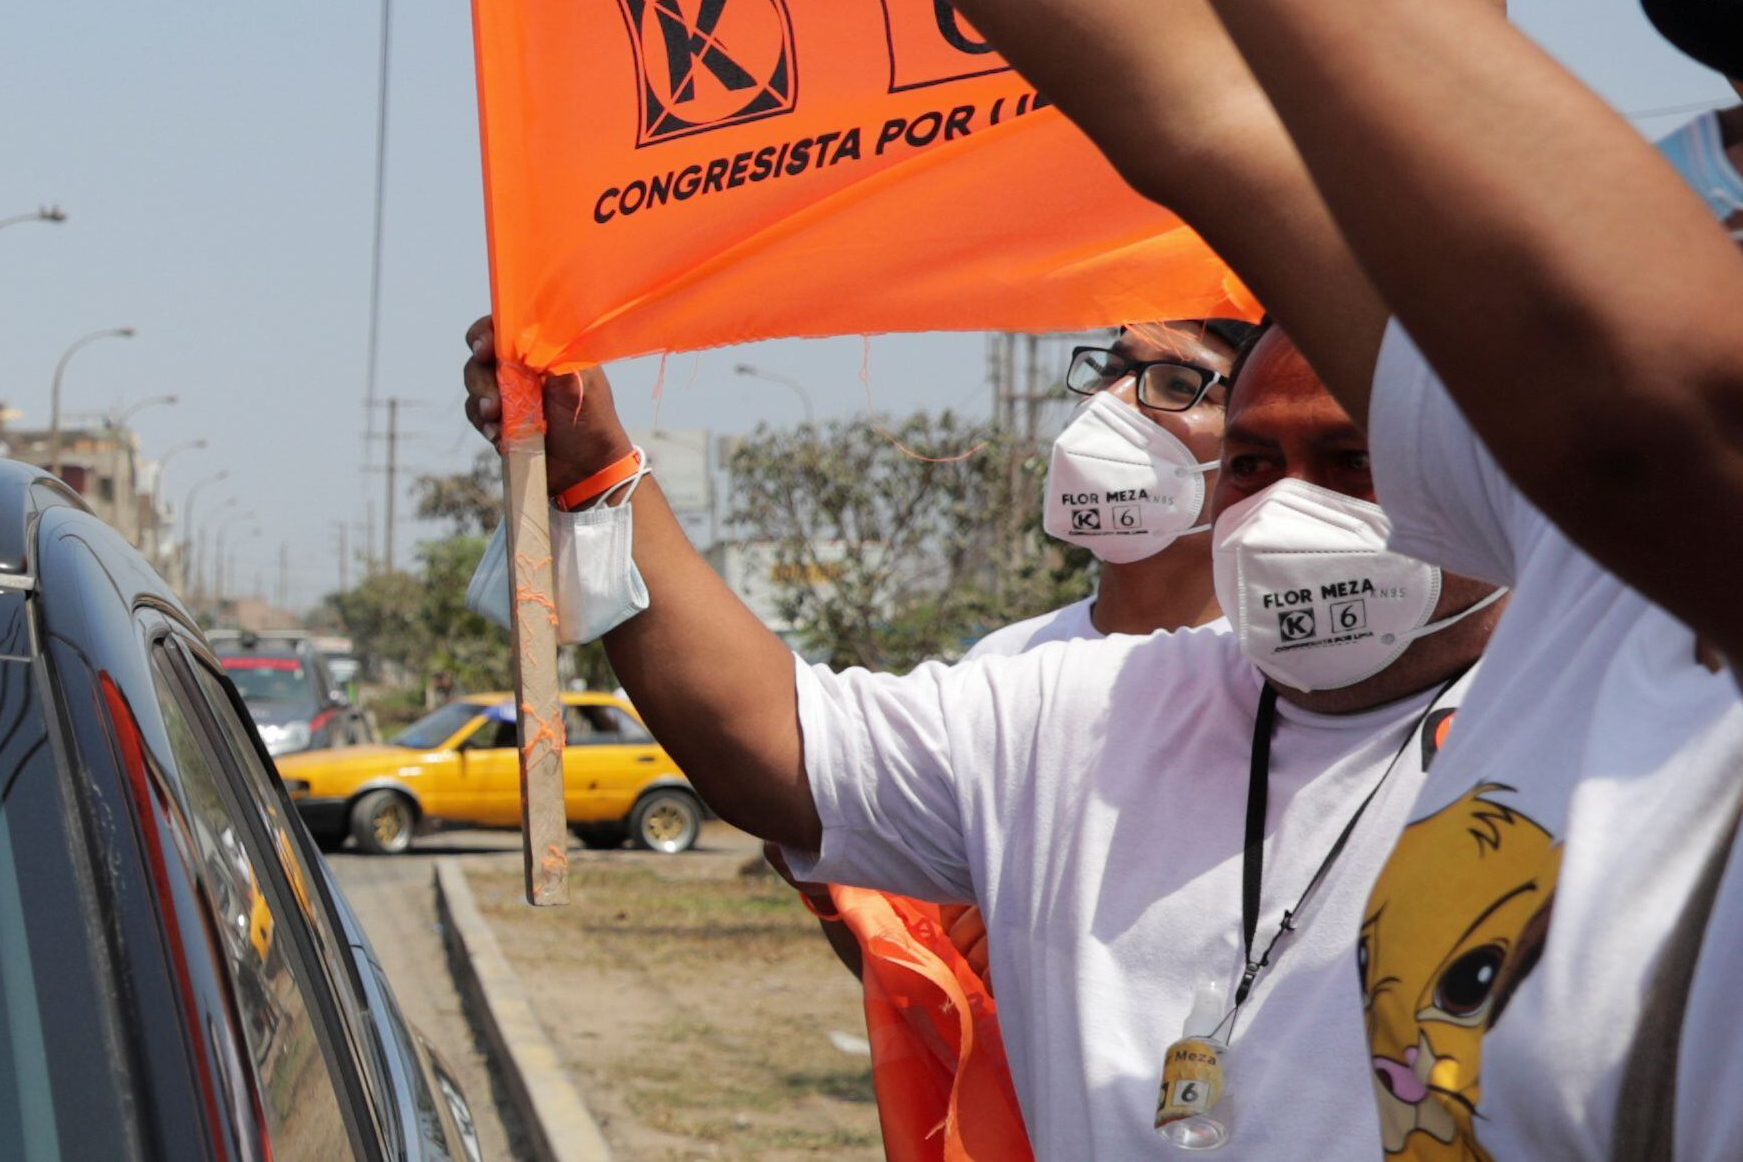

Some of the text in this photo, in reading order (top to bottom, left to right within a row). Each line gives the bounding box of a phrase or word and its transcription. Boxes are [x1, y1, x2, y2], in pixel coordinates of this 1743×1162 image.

[592, 127, 862, 224] CONGRESISTA
[874, 104, 976, 156] POR
[1061, 489, 1149, 506] FLOR MEZA
[1077, 509, 1135, 527] K 6
[1263, 578, 1375, 609] FLOR MEZA
[1286, 605, 1358, 636] K 6
[1174, 1050, 1217, 1066] Meza
[1180, 1082, 1199, 1103] 6
